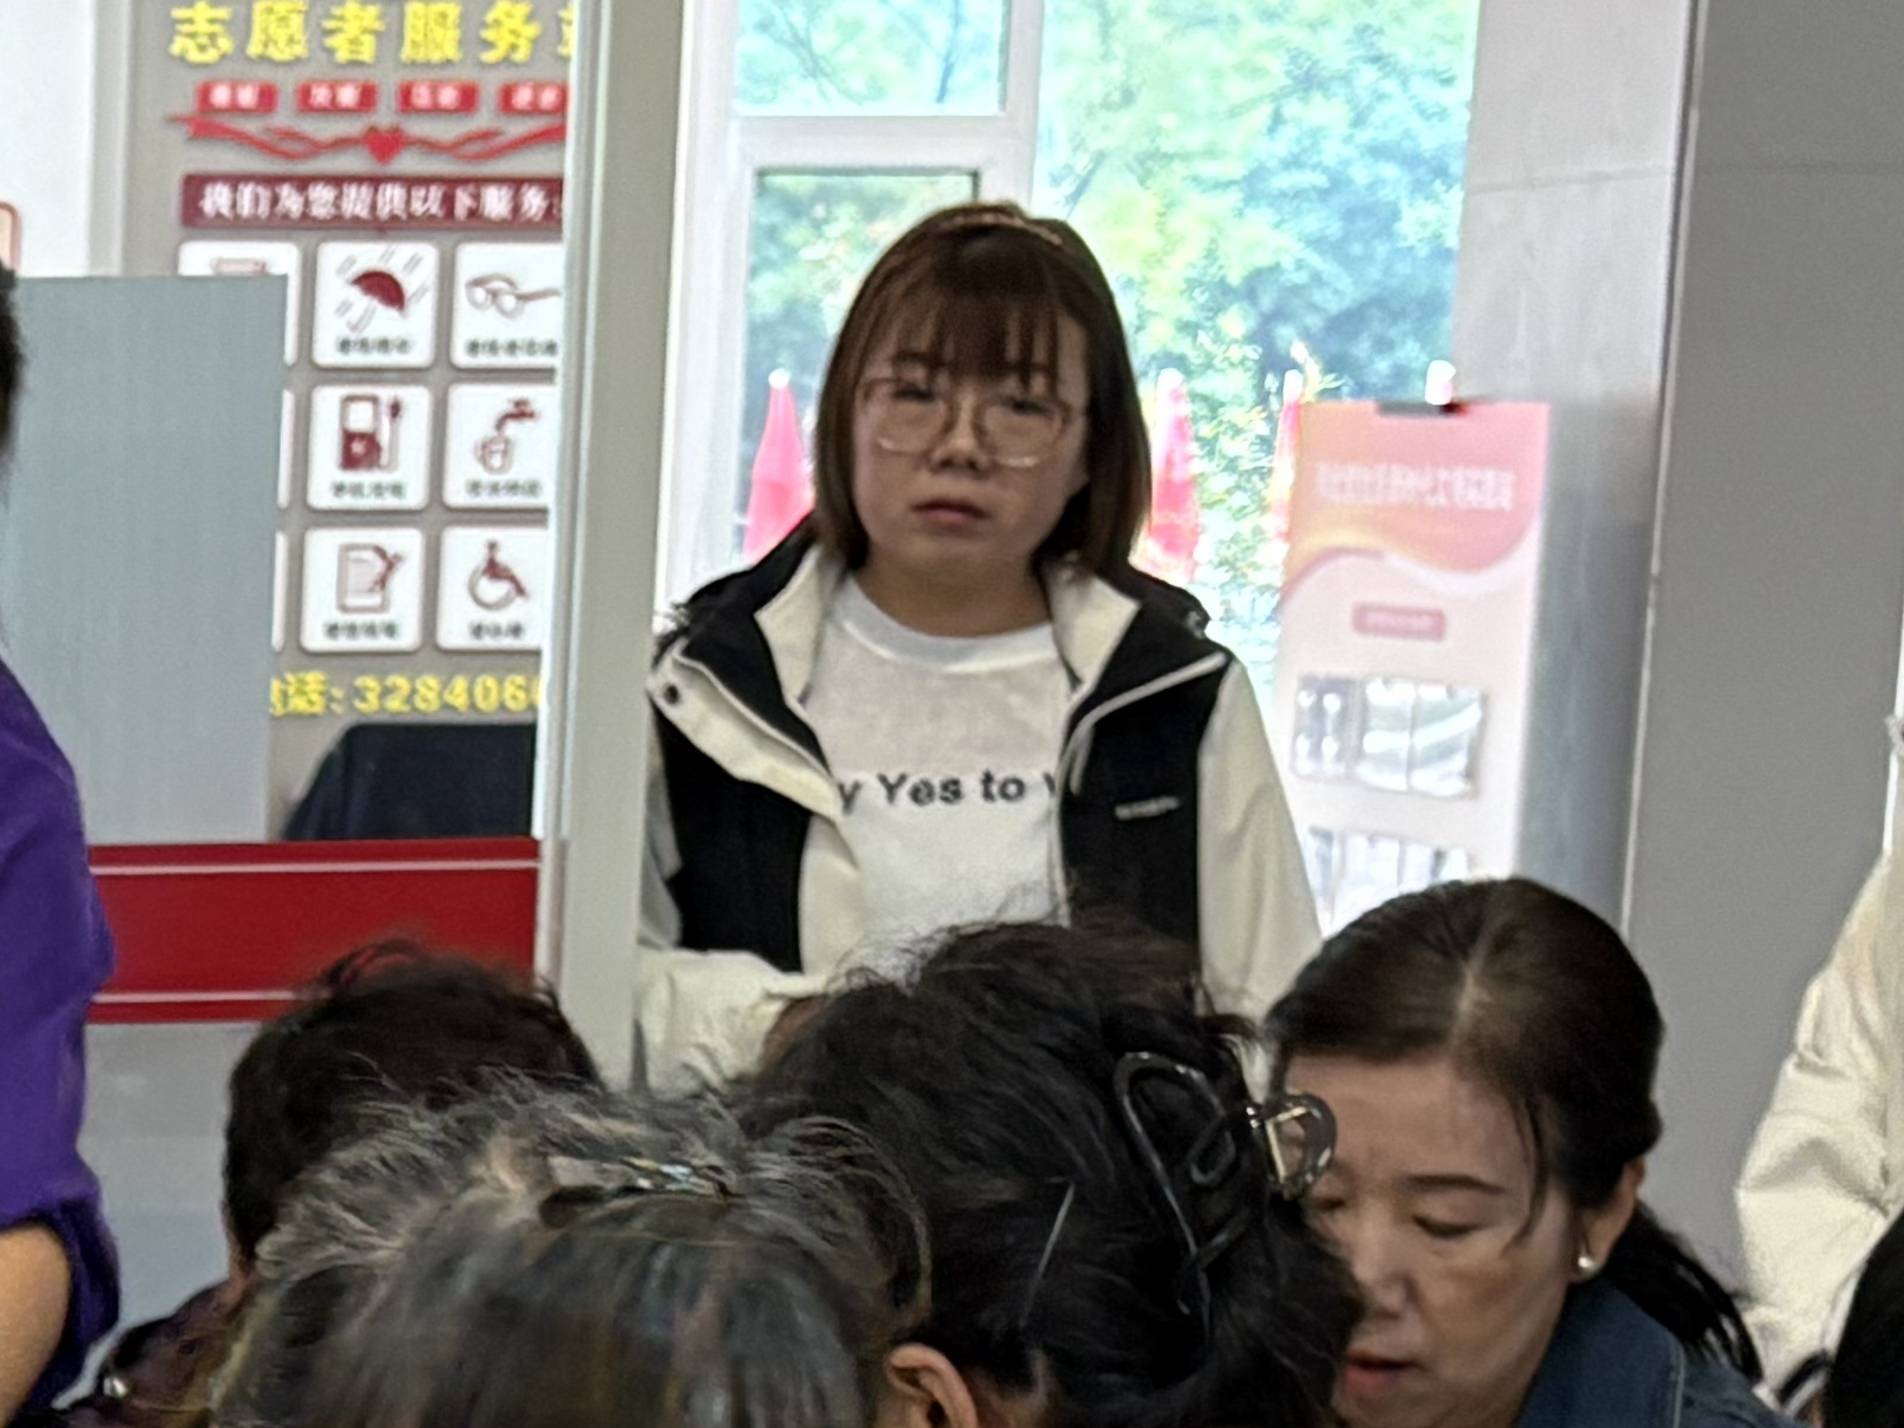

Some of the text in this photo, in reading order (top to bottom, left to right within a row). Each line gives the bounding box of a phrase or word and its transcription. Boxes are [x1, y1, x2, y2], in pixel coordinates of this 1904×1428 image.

[272, 671, 538, 716] 话:328406
[877, 773, 963, 804] Yes
[980, 768, 1027, 802] to
